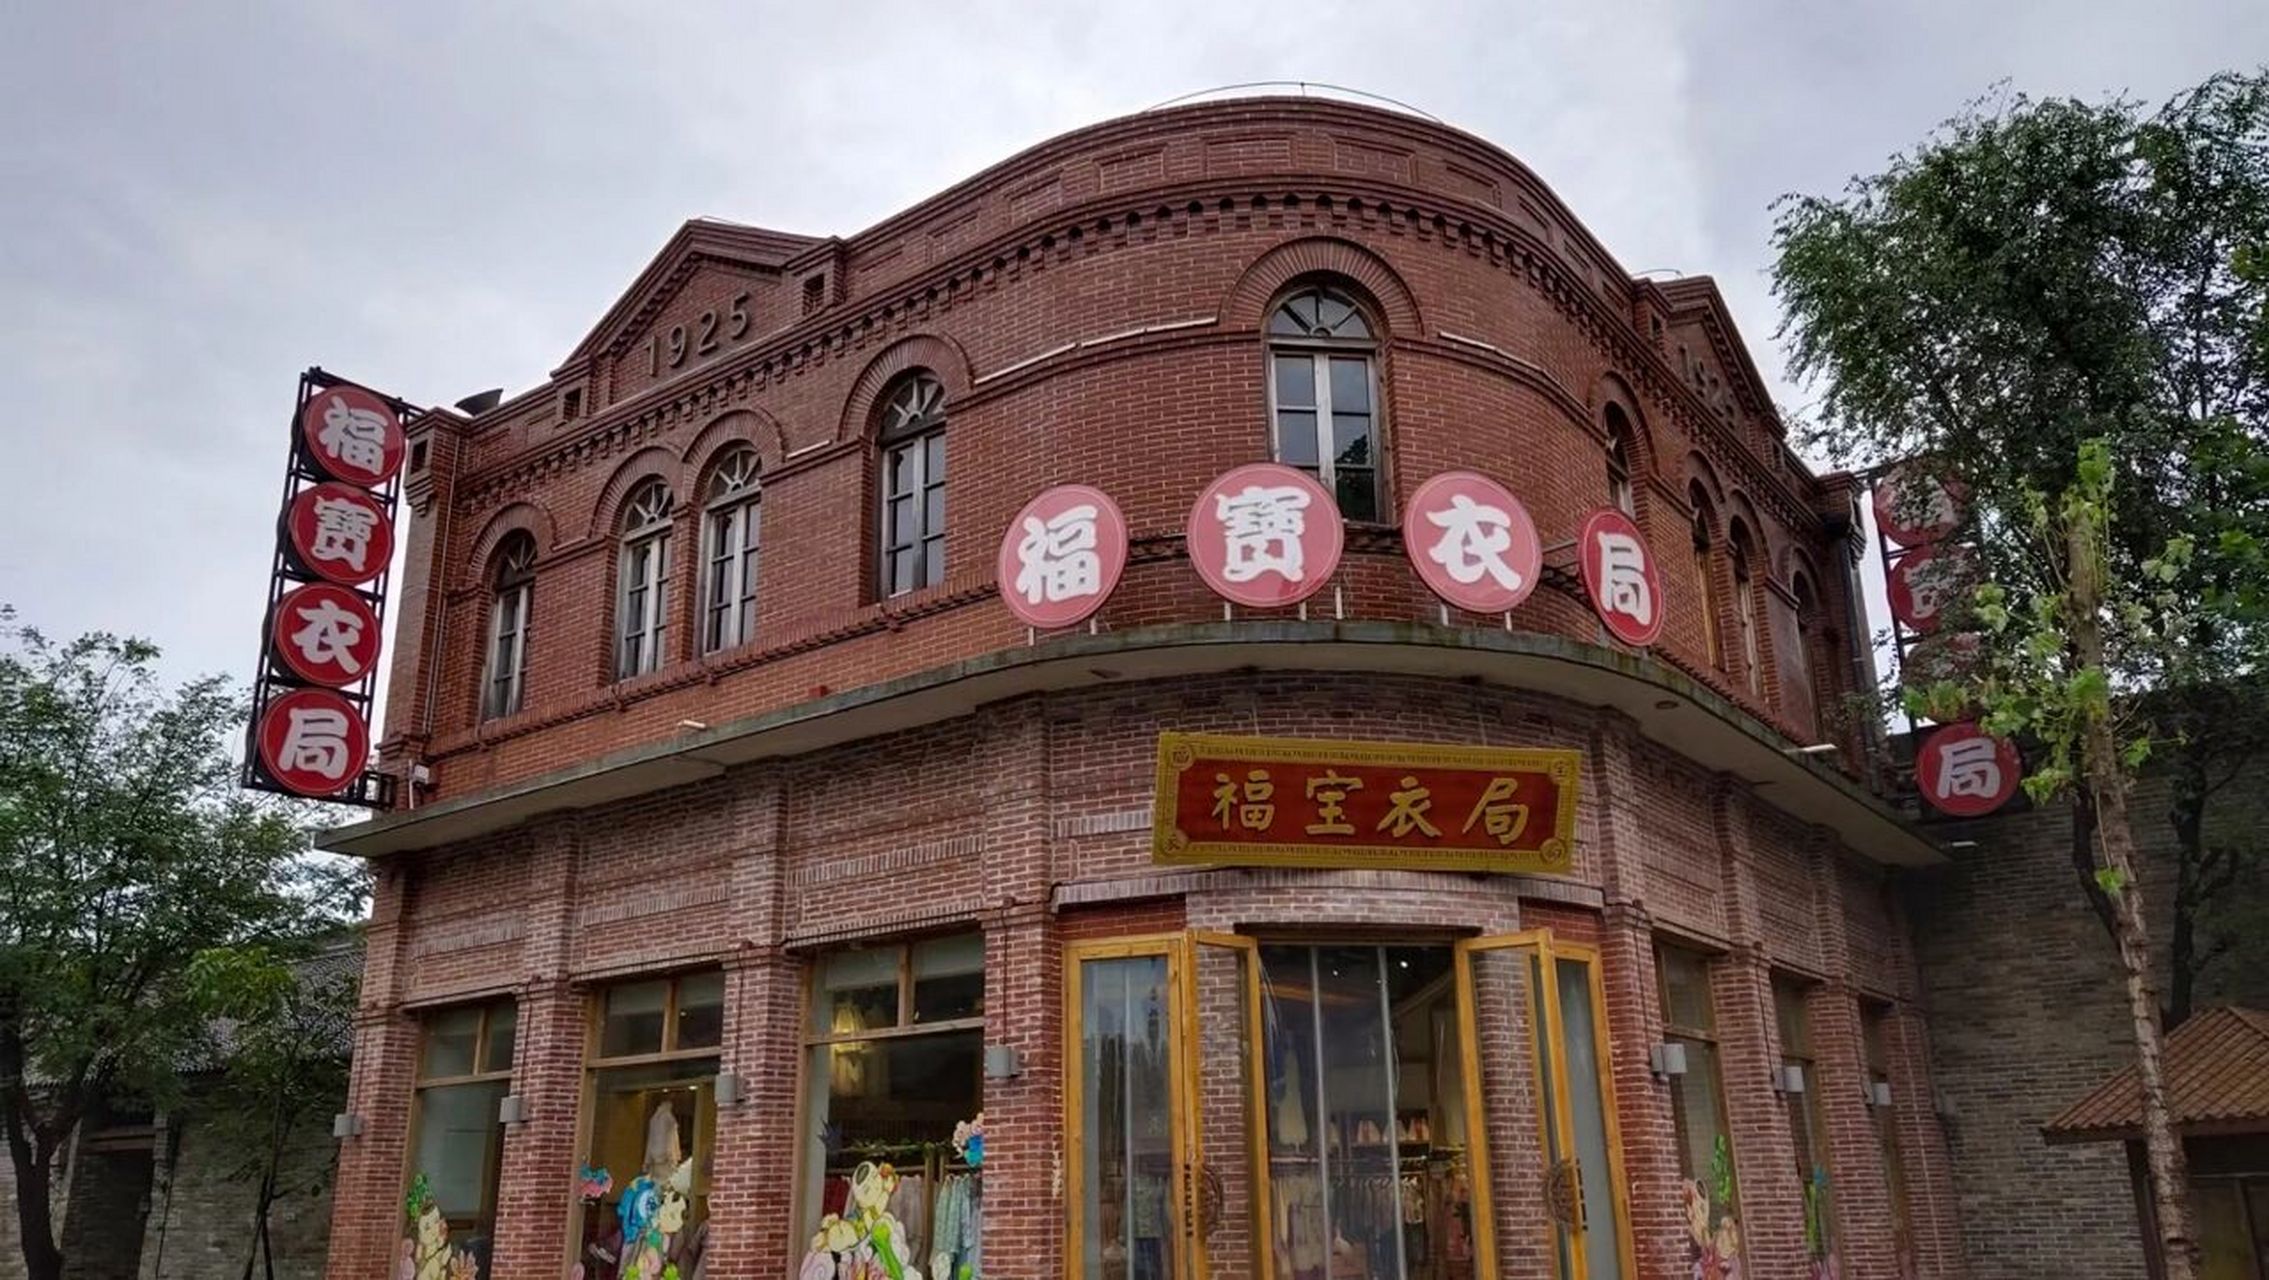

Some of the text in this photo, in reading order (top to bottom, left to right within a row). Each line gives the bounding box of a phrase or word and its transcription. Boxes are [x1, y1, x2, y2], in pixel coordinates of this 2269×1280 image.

[648, 291, 750, 378] 1925
[278, 396, 392, 780] 福寶衣局
[1015, 484, 1650, 626] 福寶衣局
[1211, 768, 1529, 844] 福宝衣局
